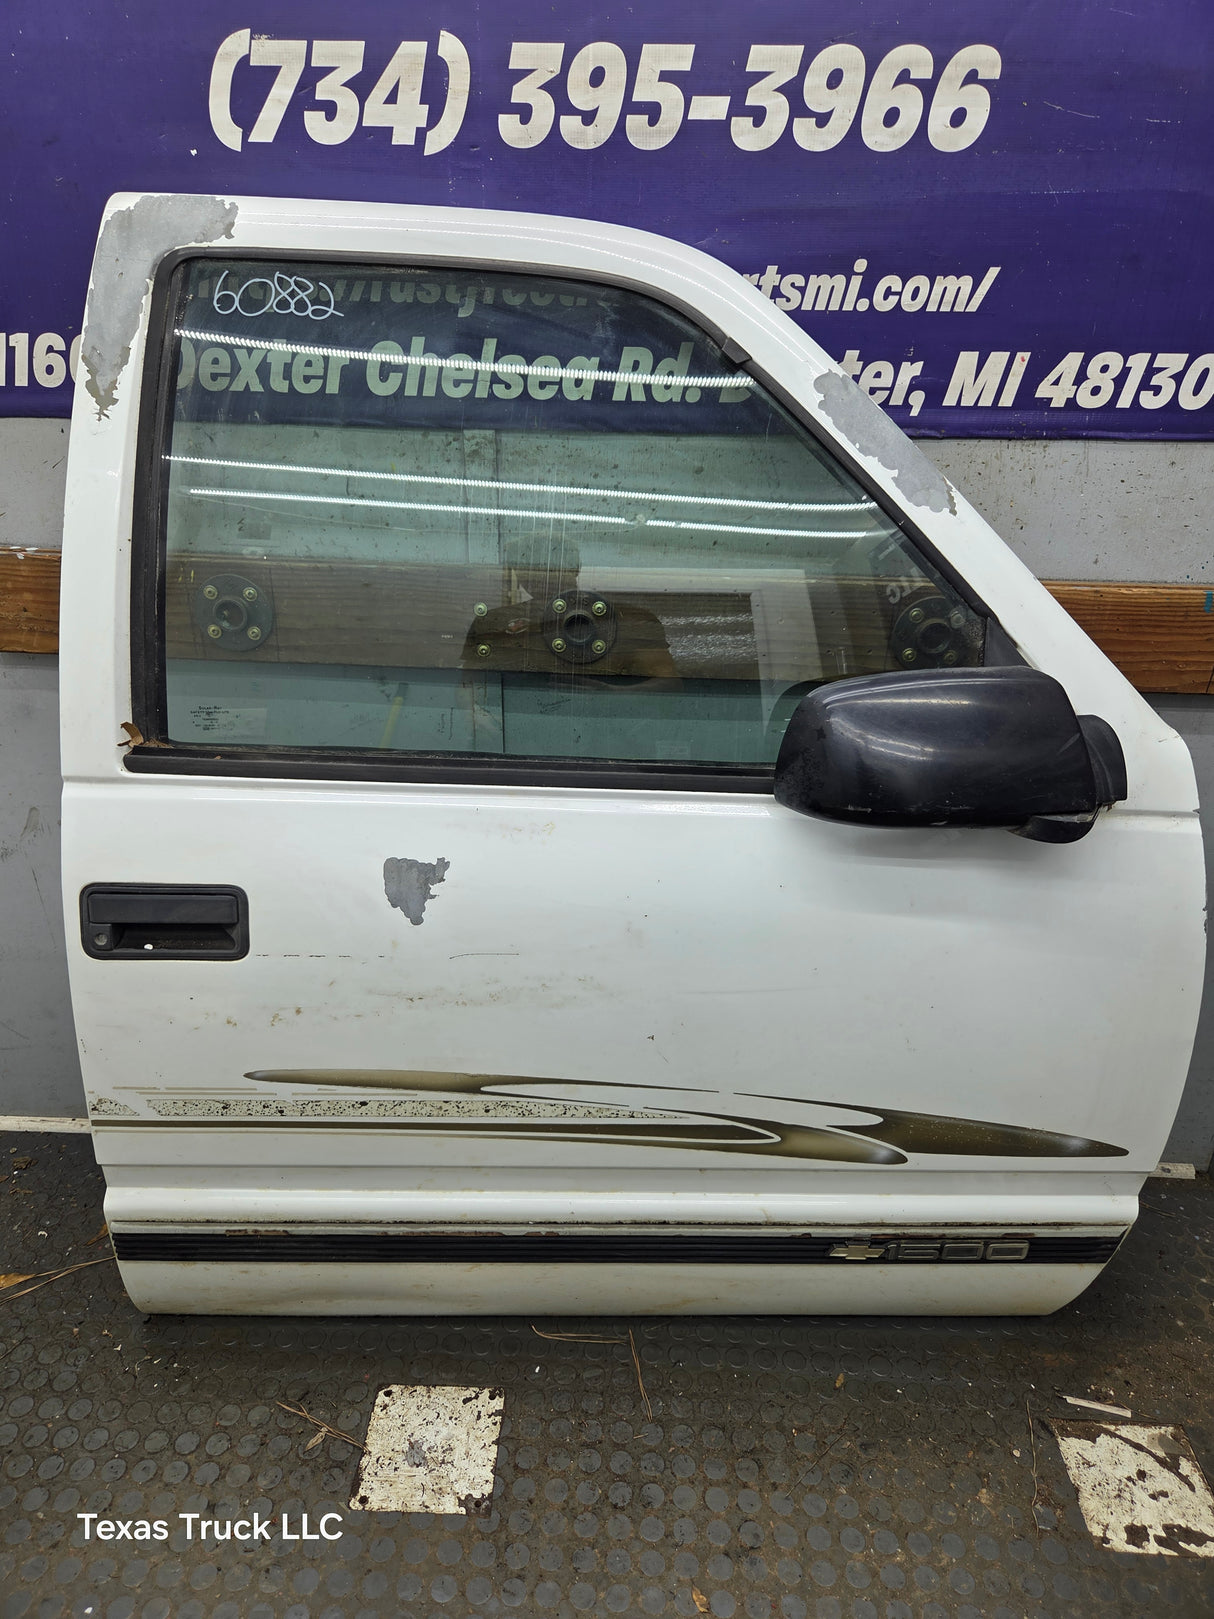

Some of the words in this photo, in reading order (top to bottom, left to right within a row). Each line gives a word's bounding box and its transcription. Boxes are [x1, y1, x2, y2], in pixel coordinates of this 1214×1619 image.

[209, 28, 471, 156] (734)
[498, 41, 1002, 153] 395-3966
[213, 270, 344, 320] 60882
[366, 336, 600, 400] Chelsea
[612, 342, 701, 403] Rd.
[942, 351, 1031, 407] MI
[1034, 351, 1214, 410] 48130
[886, 1239, 1031, 1260] 1500
